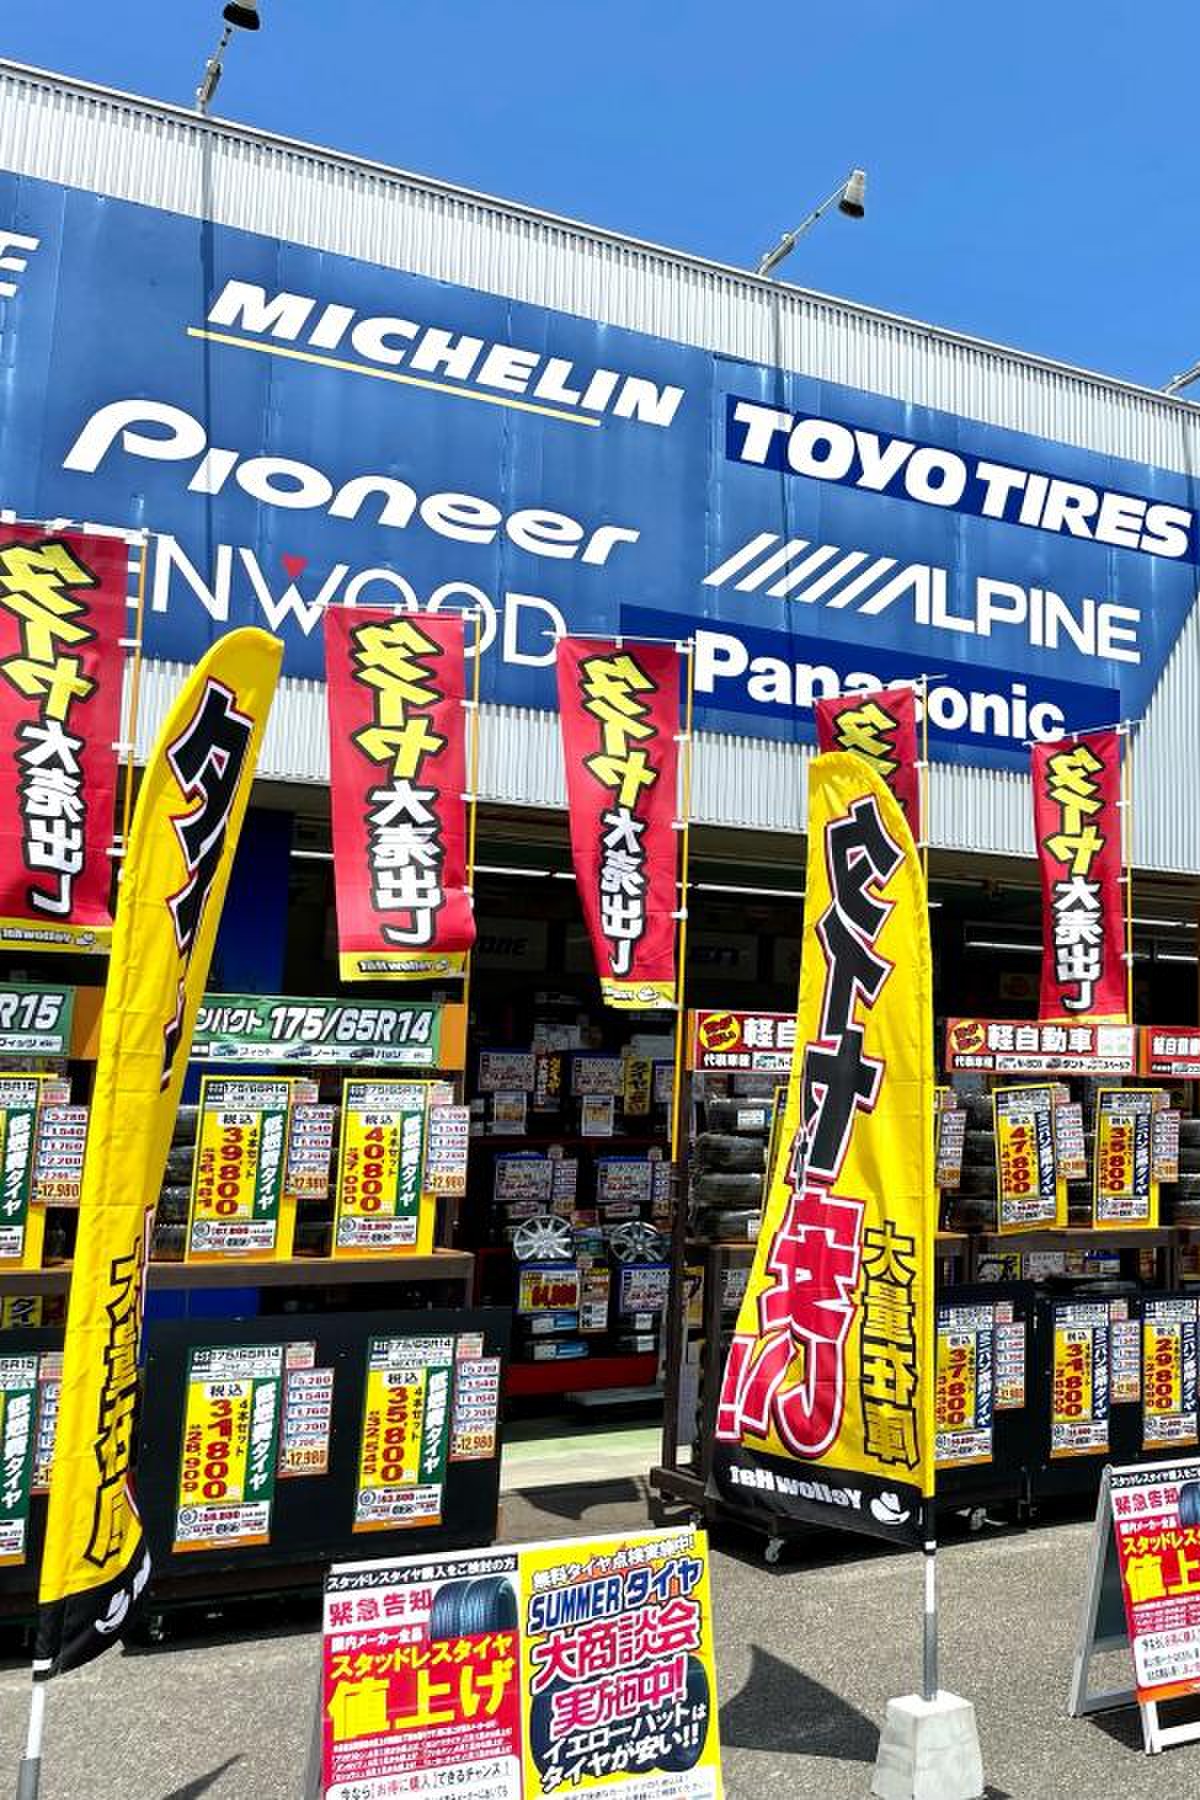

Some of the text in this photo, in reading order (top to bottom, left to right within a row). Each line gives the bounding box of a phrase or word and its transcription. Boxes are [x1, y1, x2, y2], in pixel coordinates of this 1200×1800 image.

[208, 280, 684, 427] MICHELIN
[63, 400, 640, 565] Pioneer
[734, 402, 1192, 559] TOYO TIRES
[860, 563, 1140, 663] ALPINE
[694, 630, 1065, 744] Panonic
[195, 1006, 433, 1043] ンパクト 175/65R14
[744, 1018, 796, 1048] 軽自
[988, 1024, 1093, 1052] 軽自動車
[330, 1588, 432, 1628] 緊急告知
[532, 1599, 701, 1694] 大商談会
[331, 1634, 513, 1679] スタッドレスタイヤ
[327, 1659, 516, 1742] 値上げ
[542, 1703, 707, 1765] イエローハットは
